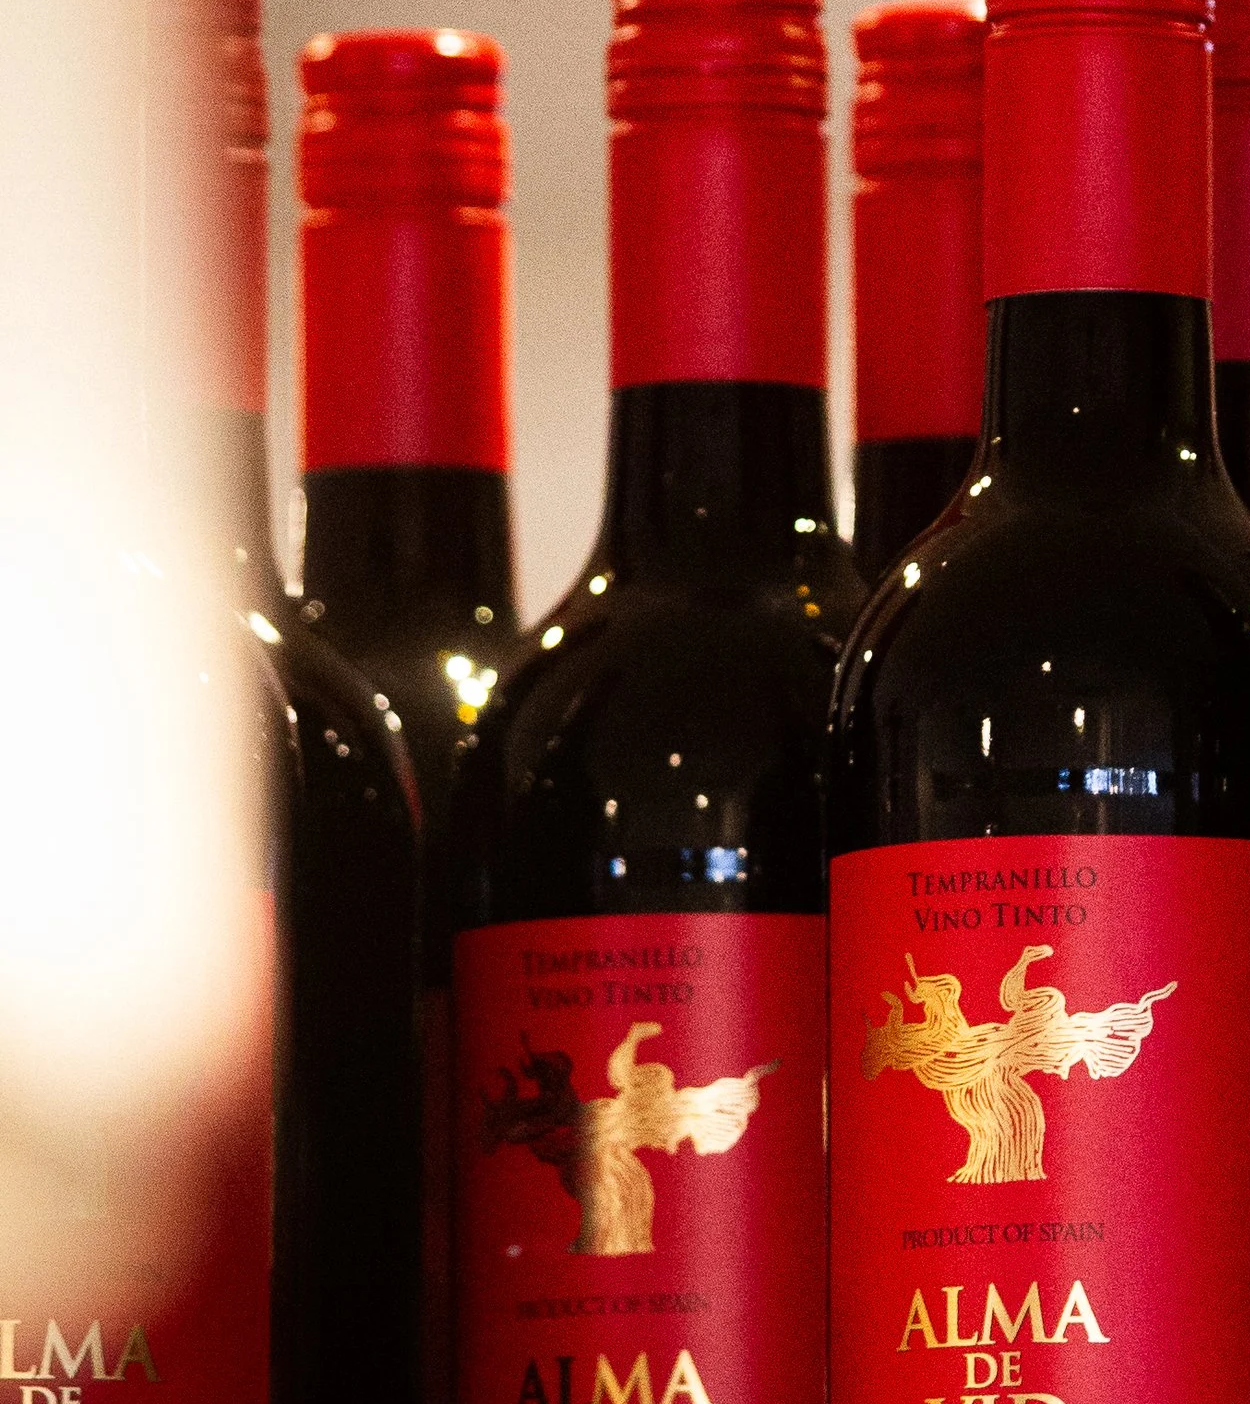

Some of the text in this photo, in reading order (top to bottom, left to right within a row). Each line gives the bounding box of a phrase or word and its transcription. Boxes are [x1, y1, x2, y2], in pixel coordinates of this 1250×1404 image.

[907, 866, 1098, 897] TEMPRANILLO
[913, 902, 1087, 932] VINO TINTO
[521, 946, 704, 977] TEMPRANILLO
[601, 979, 695, 1006] TINTO
[902, 1222, 1104, 1250] PRODUCT OF SPAIN
[896, 1279, 1110, 1352] ALMA
[0, 1318, 161, 1383] LMA
[963, 1351, 1022, 1390] DE
